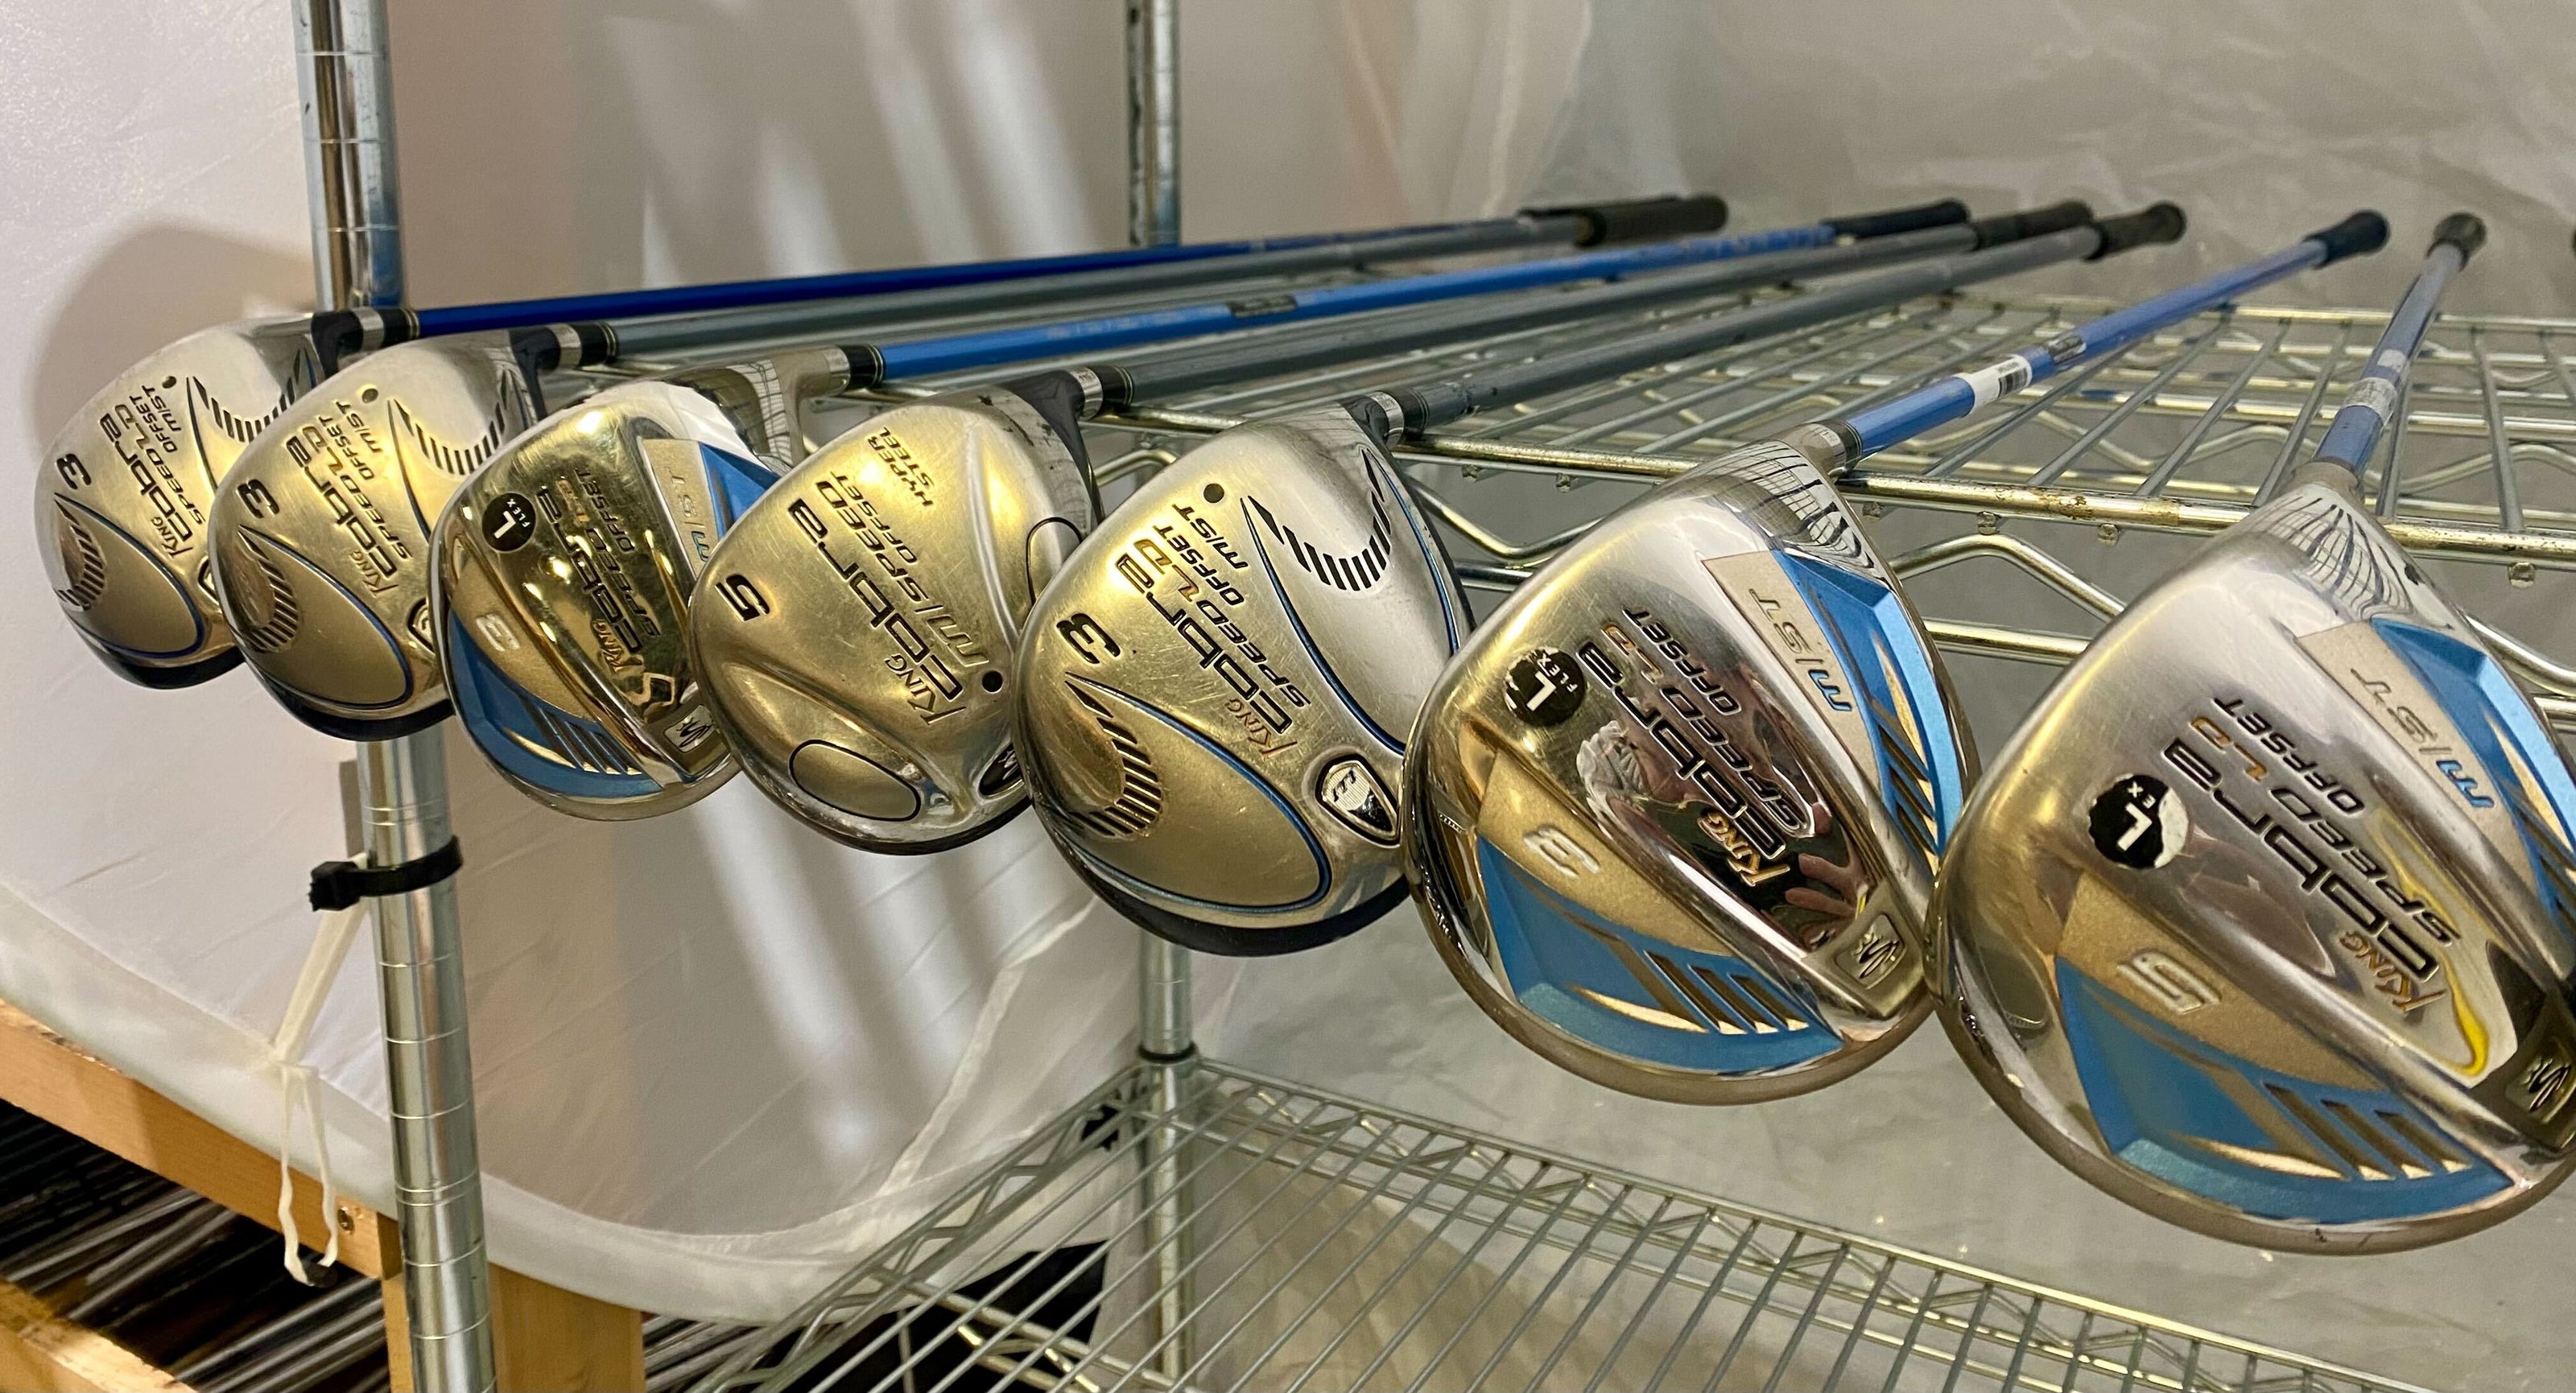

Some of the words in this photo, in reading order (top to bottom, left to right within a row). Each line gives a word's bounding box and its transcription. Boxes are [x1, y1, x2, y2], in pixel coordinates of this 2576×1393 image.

[130, 395, 178, 453] OFFSET
[319, 415, 374, 480] OFFSET
[882, 425, 935, 488] STEEL
[56, 453, 92, 490] 3
[146, 448, 206, 525] SPEED
[236, 479, 279, 518] 3
[866, 434, 934, 507] HYPER
[340, 474, 414, 559] SPEED
[494, 509, 516, 539] L
[507, 497, 530, 528] FLEX
[574, 467, 635, 554] OFFSET
[831, 471, 919, 564] OFFSET
[585, 528, 662, 637] SPEED
[1133, 538, 1200, 604] LD
[1153, 523, 1245, 606] OFFSET
[716, 573, 770, 622] 5
[1056, 612, 1121, 665] 3
[1196, 599, 1311, 708] SPEED
[1622, 605, 1741, 716] OFFSET
[1526, 671, 1557, 712] L
[1536, 652, 1579, 694] FLEX
[1659, 686, 1812, 837] SPEED
[2190, 715, 2267, 783] LD
[2212, 697, 2365, 817] OFFSET
[2118, 805, 2153, 852] L
[2126, 782, 2155, 810] EX
[1523, 823, 1603, 880] 3
[2268, 785, 2462, 948] SPEED
[2117, 952, 2223, 1016] 5
